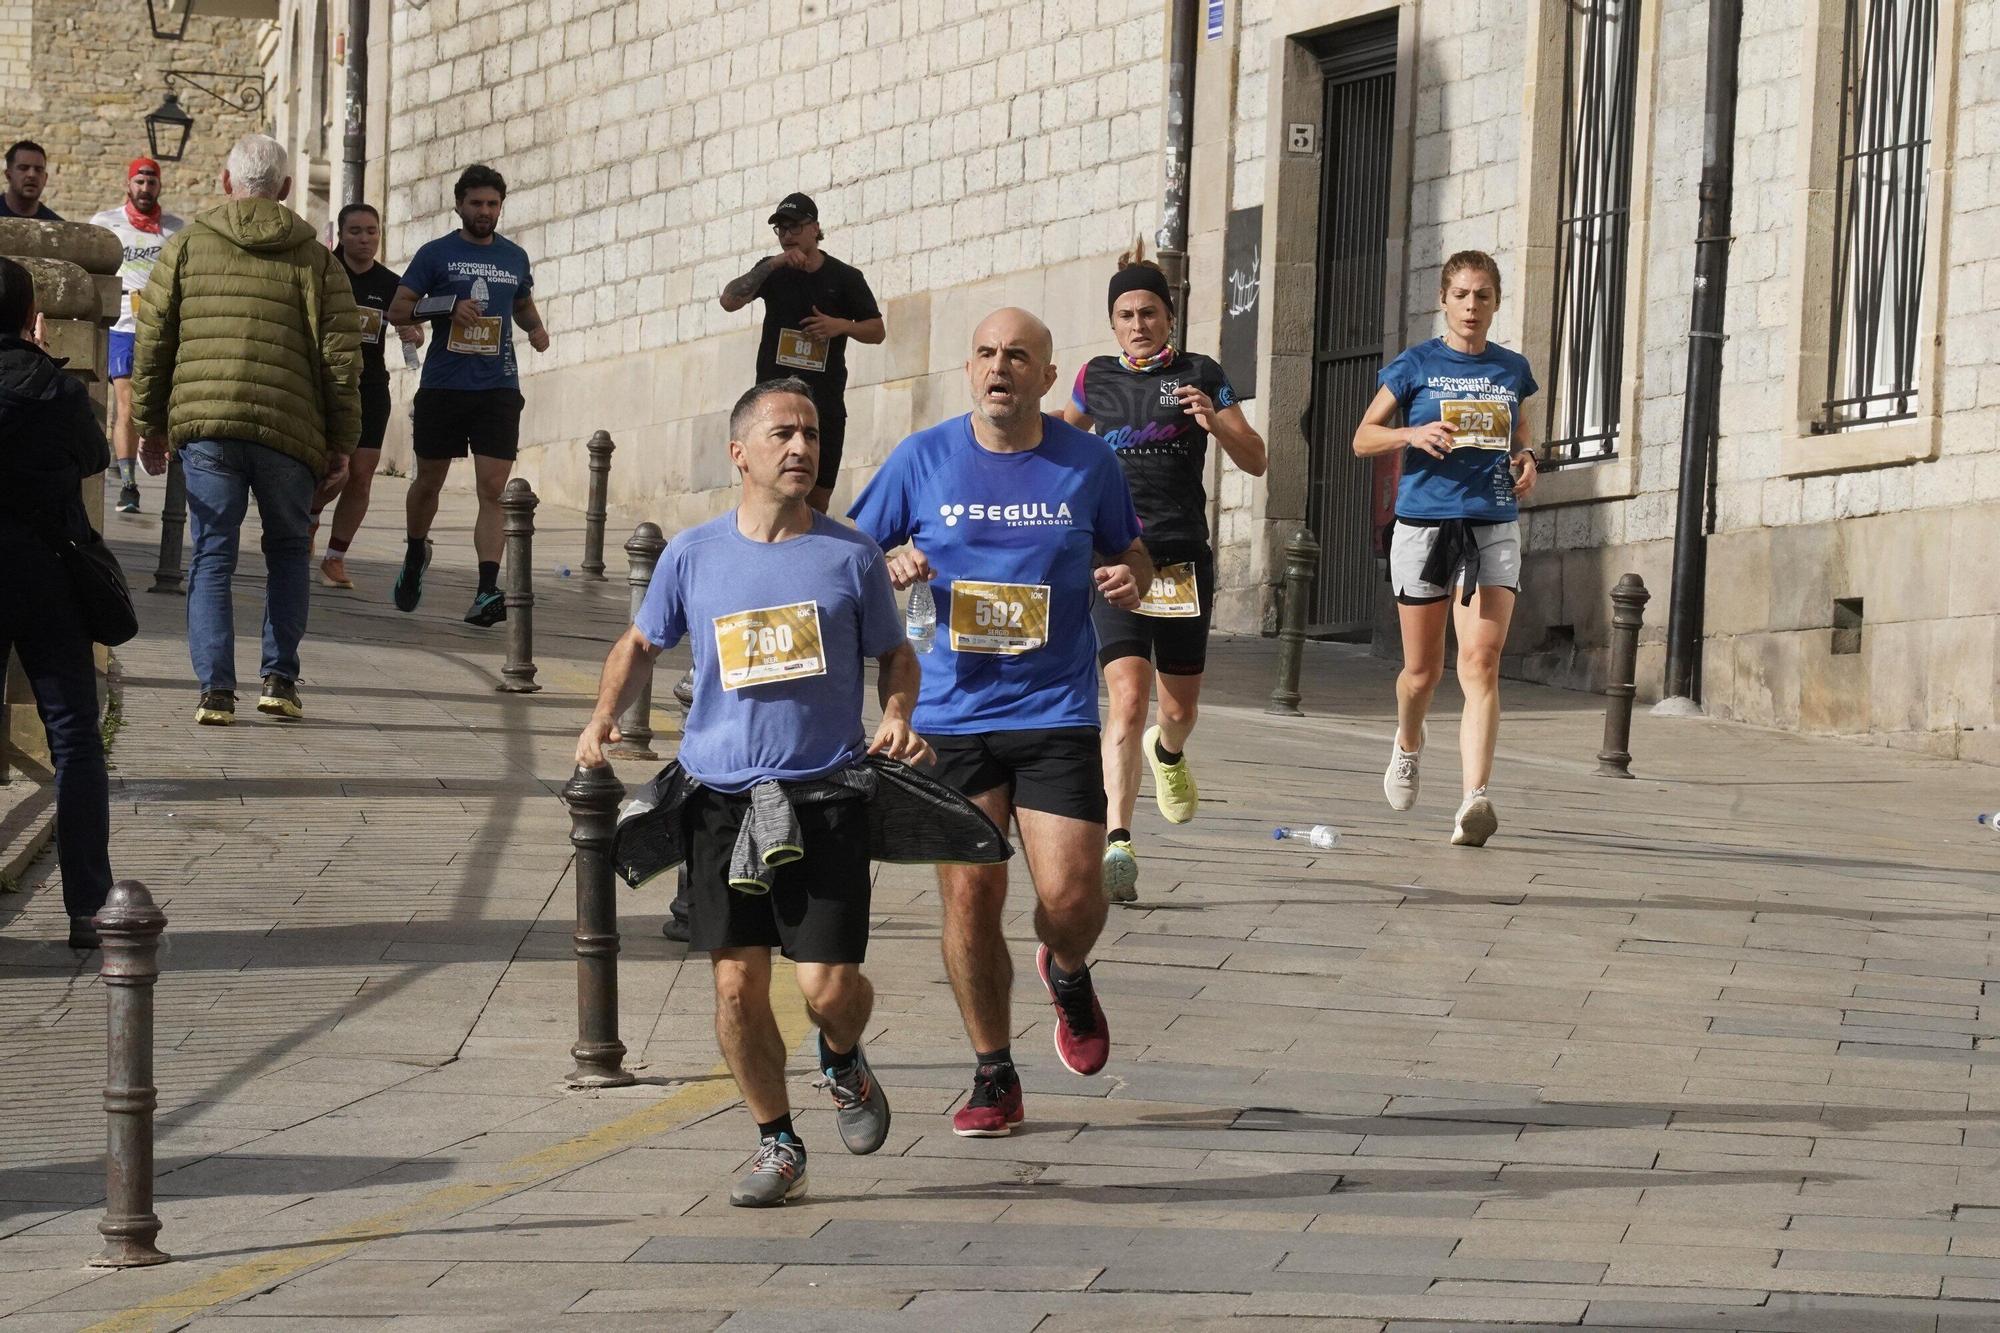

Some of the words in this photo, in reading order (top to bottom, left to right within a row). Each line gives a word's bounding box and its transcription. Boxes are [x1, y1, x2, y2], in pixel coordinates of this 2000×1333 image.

[1294, 127, 1309, 148] 5
[457, 262, 497, 270] CONQUISTA
[487, 276, 518, 285] KONKISTA
[464, 326, 490, 341] 604
[795, 340, 812, 356] 88
[1427, 376, 1439, 384] LA
[1439, 376, 1491, 385] CONQUISTA
[1160, 395, 1179, 406] OTSO
[1479, 392, 1518, 402] KONKISTA
[1460, 411, 1494, 431] 525
[968, 502, 1072, 521] SEGULA
[1007, 519, 1073, 527] TECHNOLOGIES
[1146, 577, 1177, 598] 98
[975, 600, 1024, 628] 592
[742, 624, 794, 657] 260
